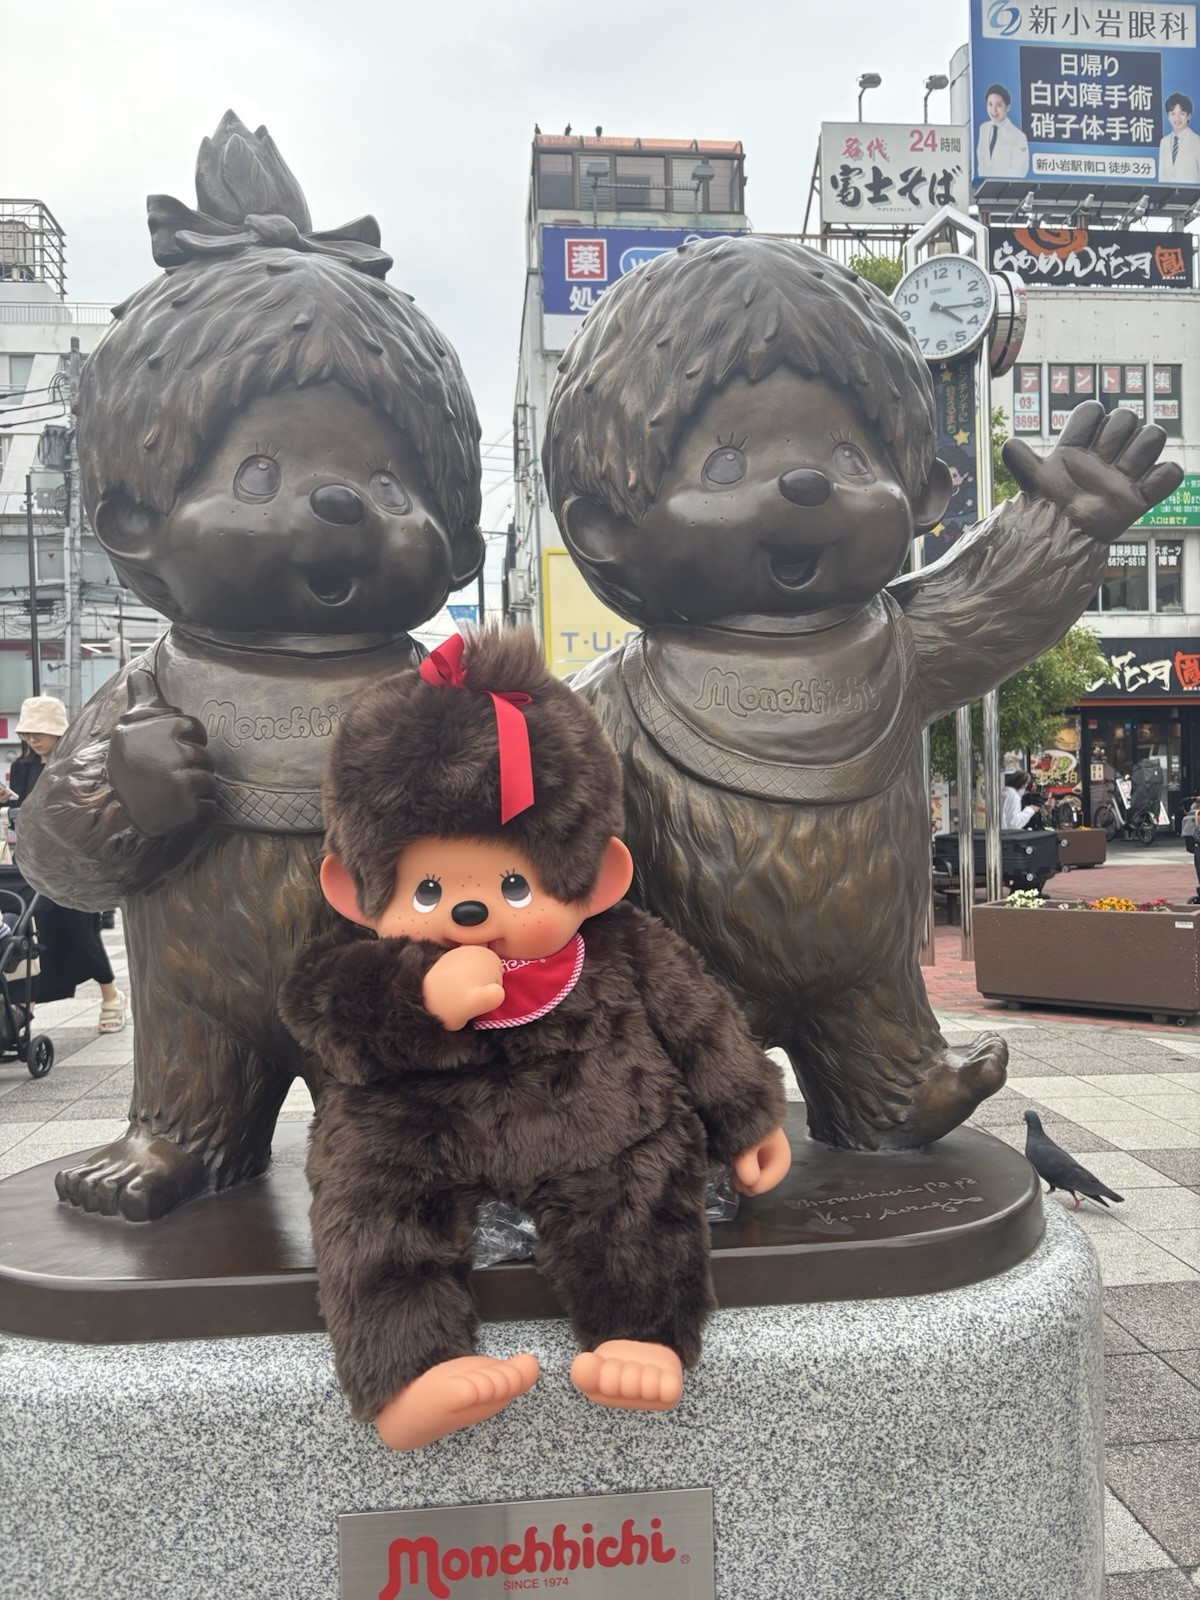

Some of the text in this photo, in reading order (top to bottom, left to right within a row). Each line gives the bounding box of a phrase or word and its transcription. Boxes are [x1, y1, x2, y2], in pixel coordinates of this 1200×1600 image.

[1028, 4, 1189, 41] 新小岩眼科
[1060, 53, 1120, 78] 日帰り
[1030, 79, 1153, 111] 白内障手術
[1031, 112, 1155, 143] 硝子体手術
[909, 129, 961, 153] 24時間
[842, 137, 889, 161] 名代
[1036, 158, 1152, 175] 新小岩駅南口 徒歩3分
[830, 164, 962, 207] 富士そば
[571, 244, 601, 276] 薬
[933, 267, 948, 280] 12
[957, 268, 962, 280] 1
[915, 277, 928, 290] 11
[967, 280, 979, 293] 2
[903, 293, 919, 305] 10
[972, 297, 984, 308] 3
[900, 310, 911, 322] 9
[966, 314, 980, 326] 4
[955, 330, 967, 342] 5
[919, 338, 930, 350] 7
[935, 340, 948, 351] 6
[1022, 371, 1170, 393] テナント募集
[1019, 396, 1035, 409] 03-
[1015, 415, 1039, 431] 3695
[1155, 545, 1182, 556] スポーツ
[379, 1517, 676, 1600] Monchhichi
[503, 1577, 570, 1591] SINCE 1974
